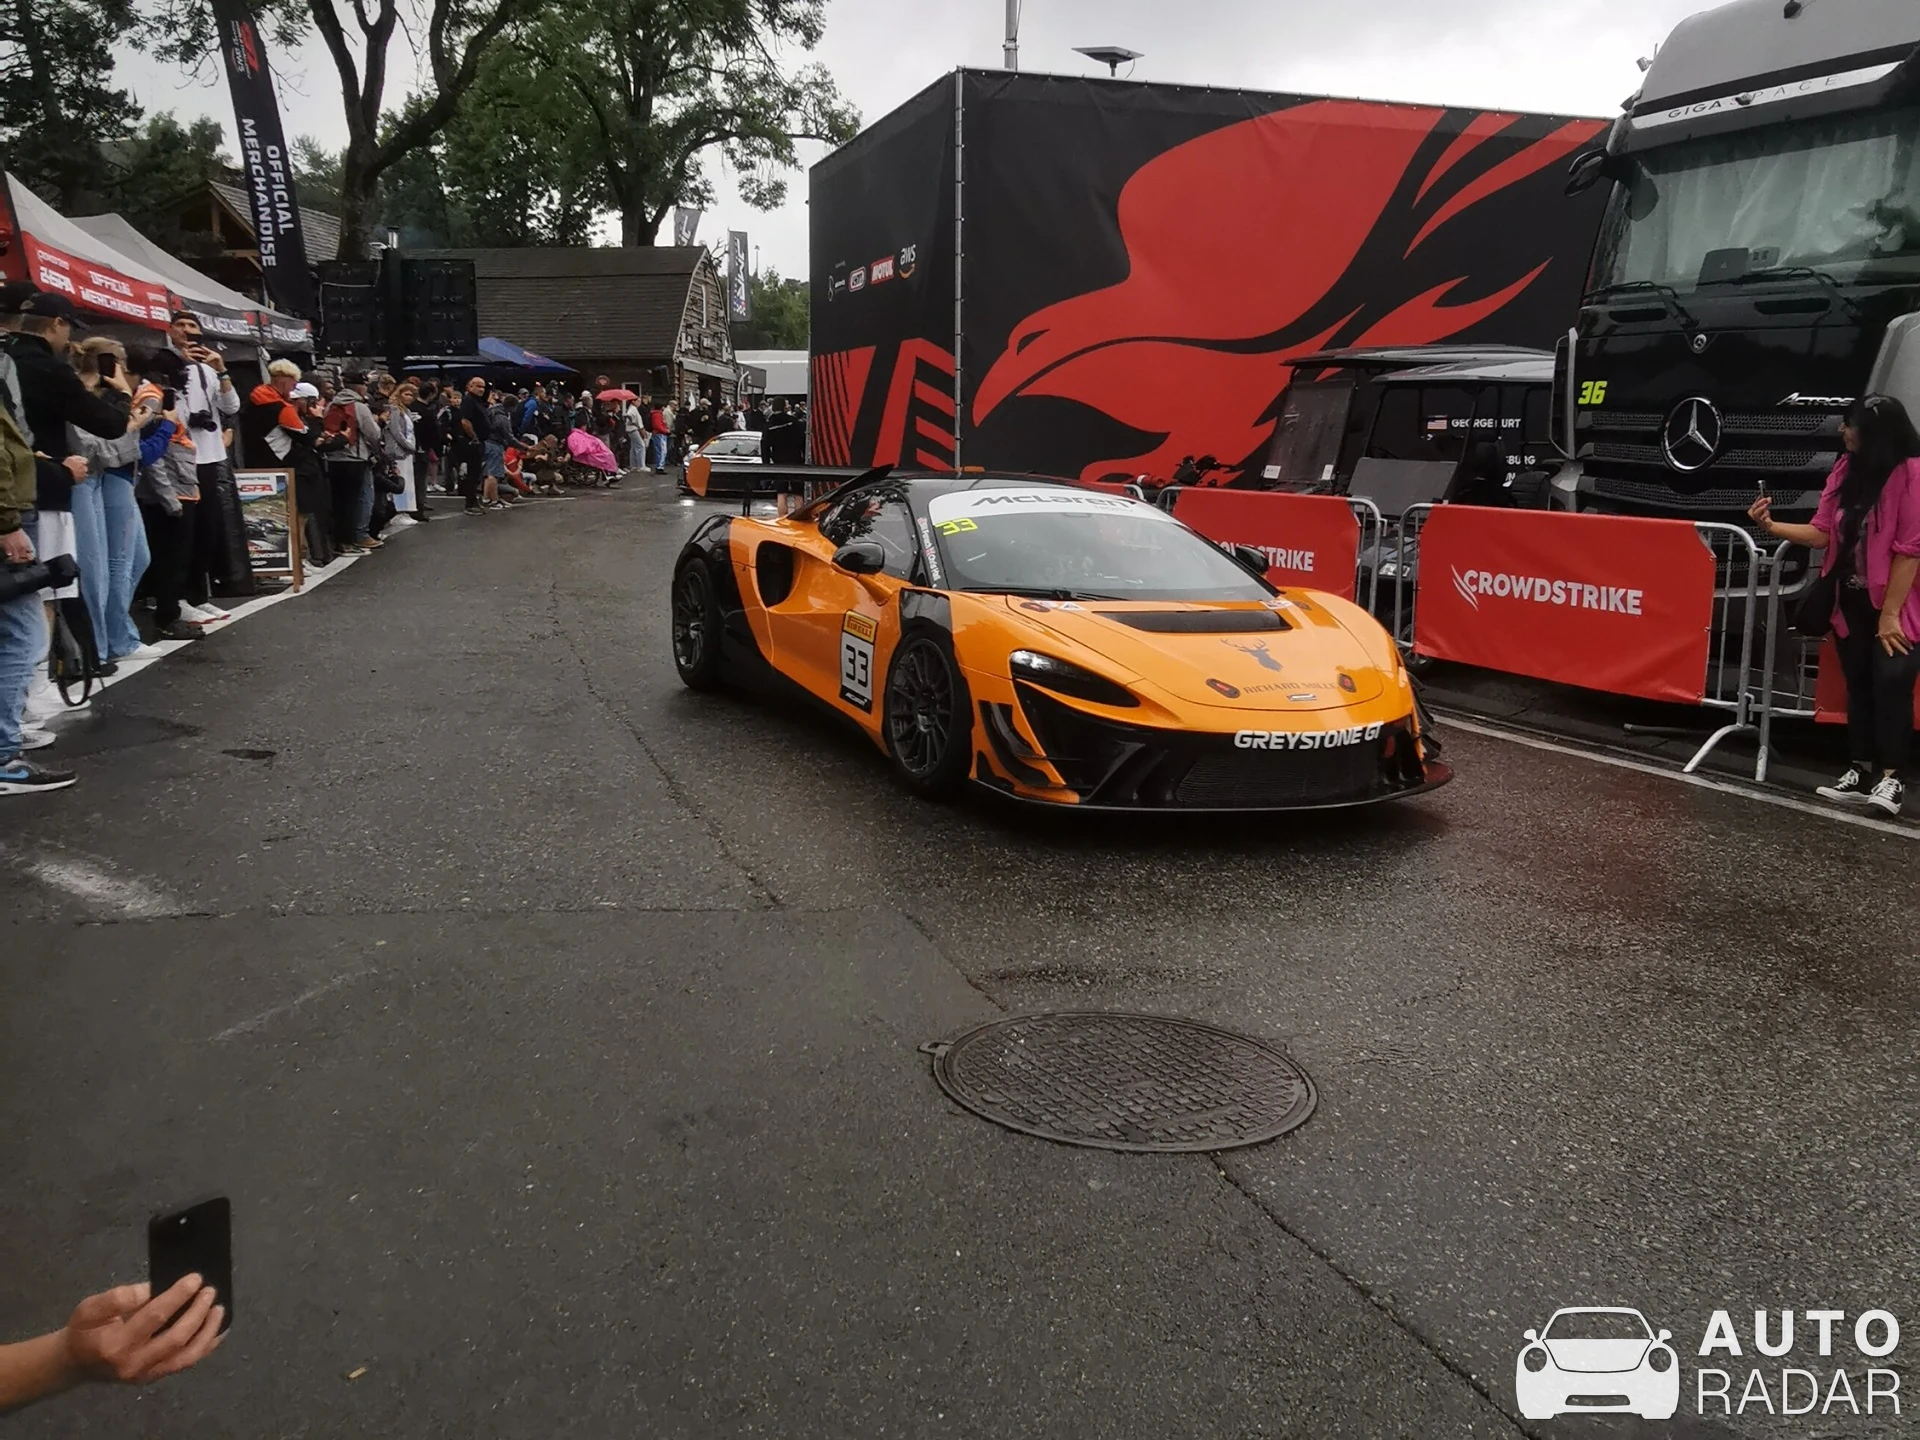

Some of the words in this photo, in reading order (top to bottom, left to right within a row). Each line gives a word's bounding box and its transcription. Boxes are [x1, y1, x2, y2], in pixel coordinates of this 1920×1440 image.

[241, 118, 277, 267] MERCHANDISE
[266, 145, 295, 235] OFFICIAL
[900, 244, 916, 265] aws
[872, 260, 893, 282] MOTUL
[1578, 381, 1607, 404] 36
[971, 494, 1132, 508] McLaren
[935, 518, 979, 536] 33
[1463, 569, 1643, 615] CROWDSTRIKE
[846, 644, 868, 688] 33
[1243, 682, 1299, 694] RICHARD
[1234, 727, 1361, 750] GREYSTONE
[1363, 721, 1384, 741] GT
